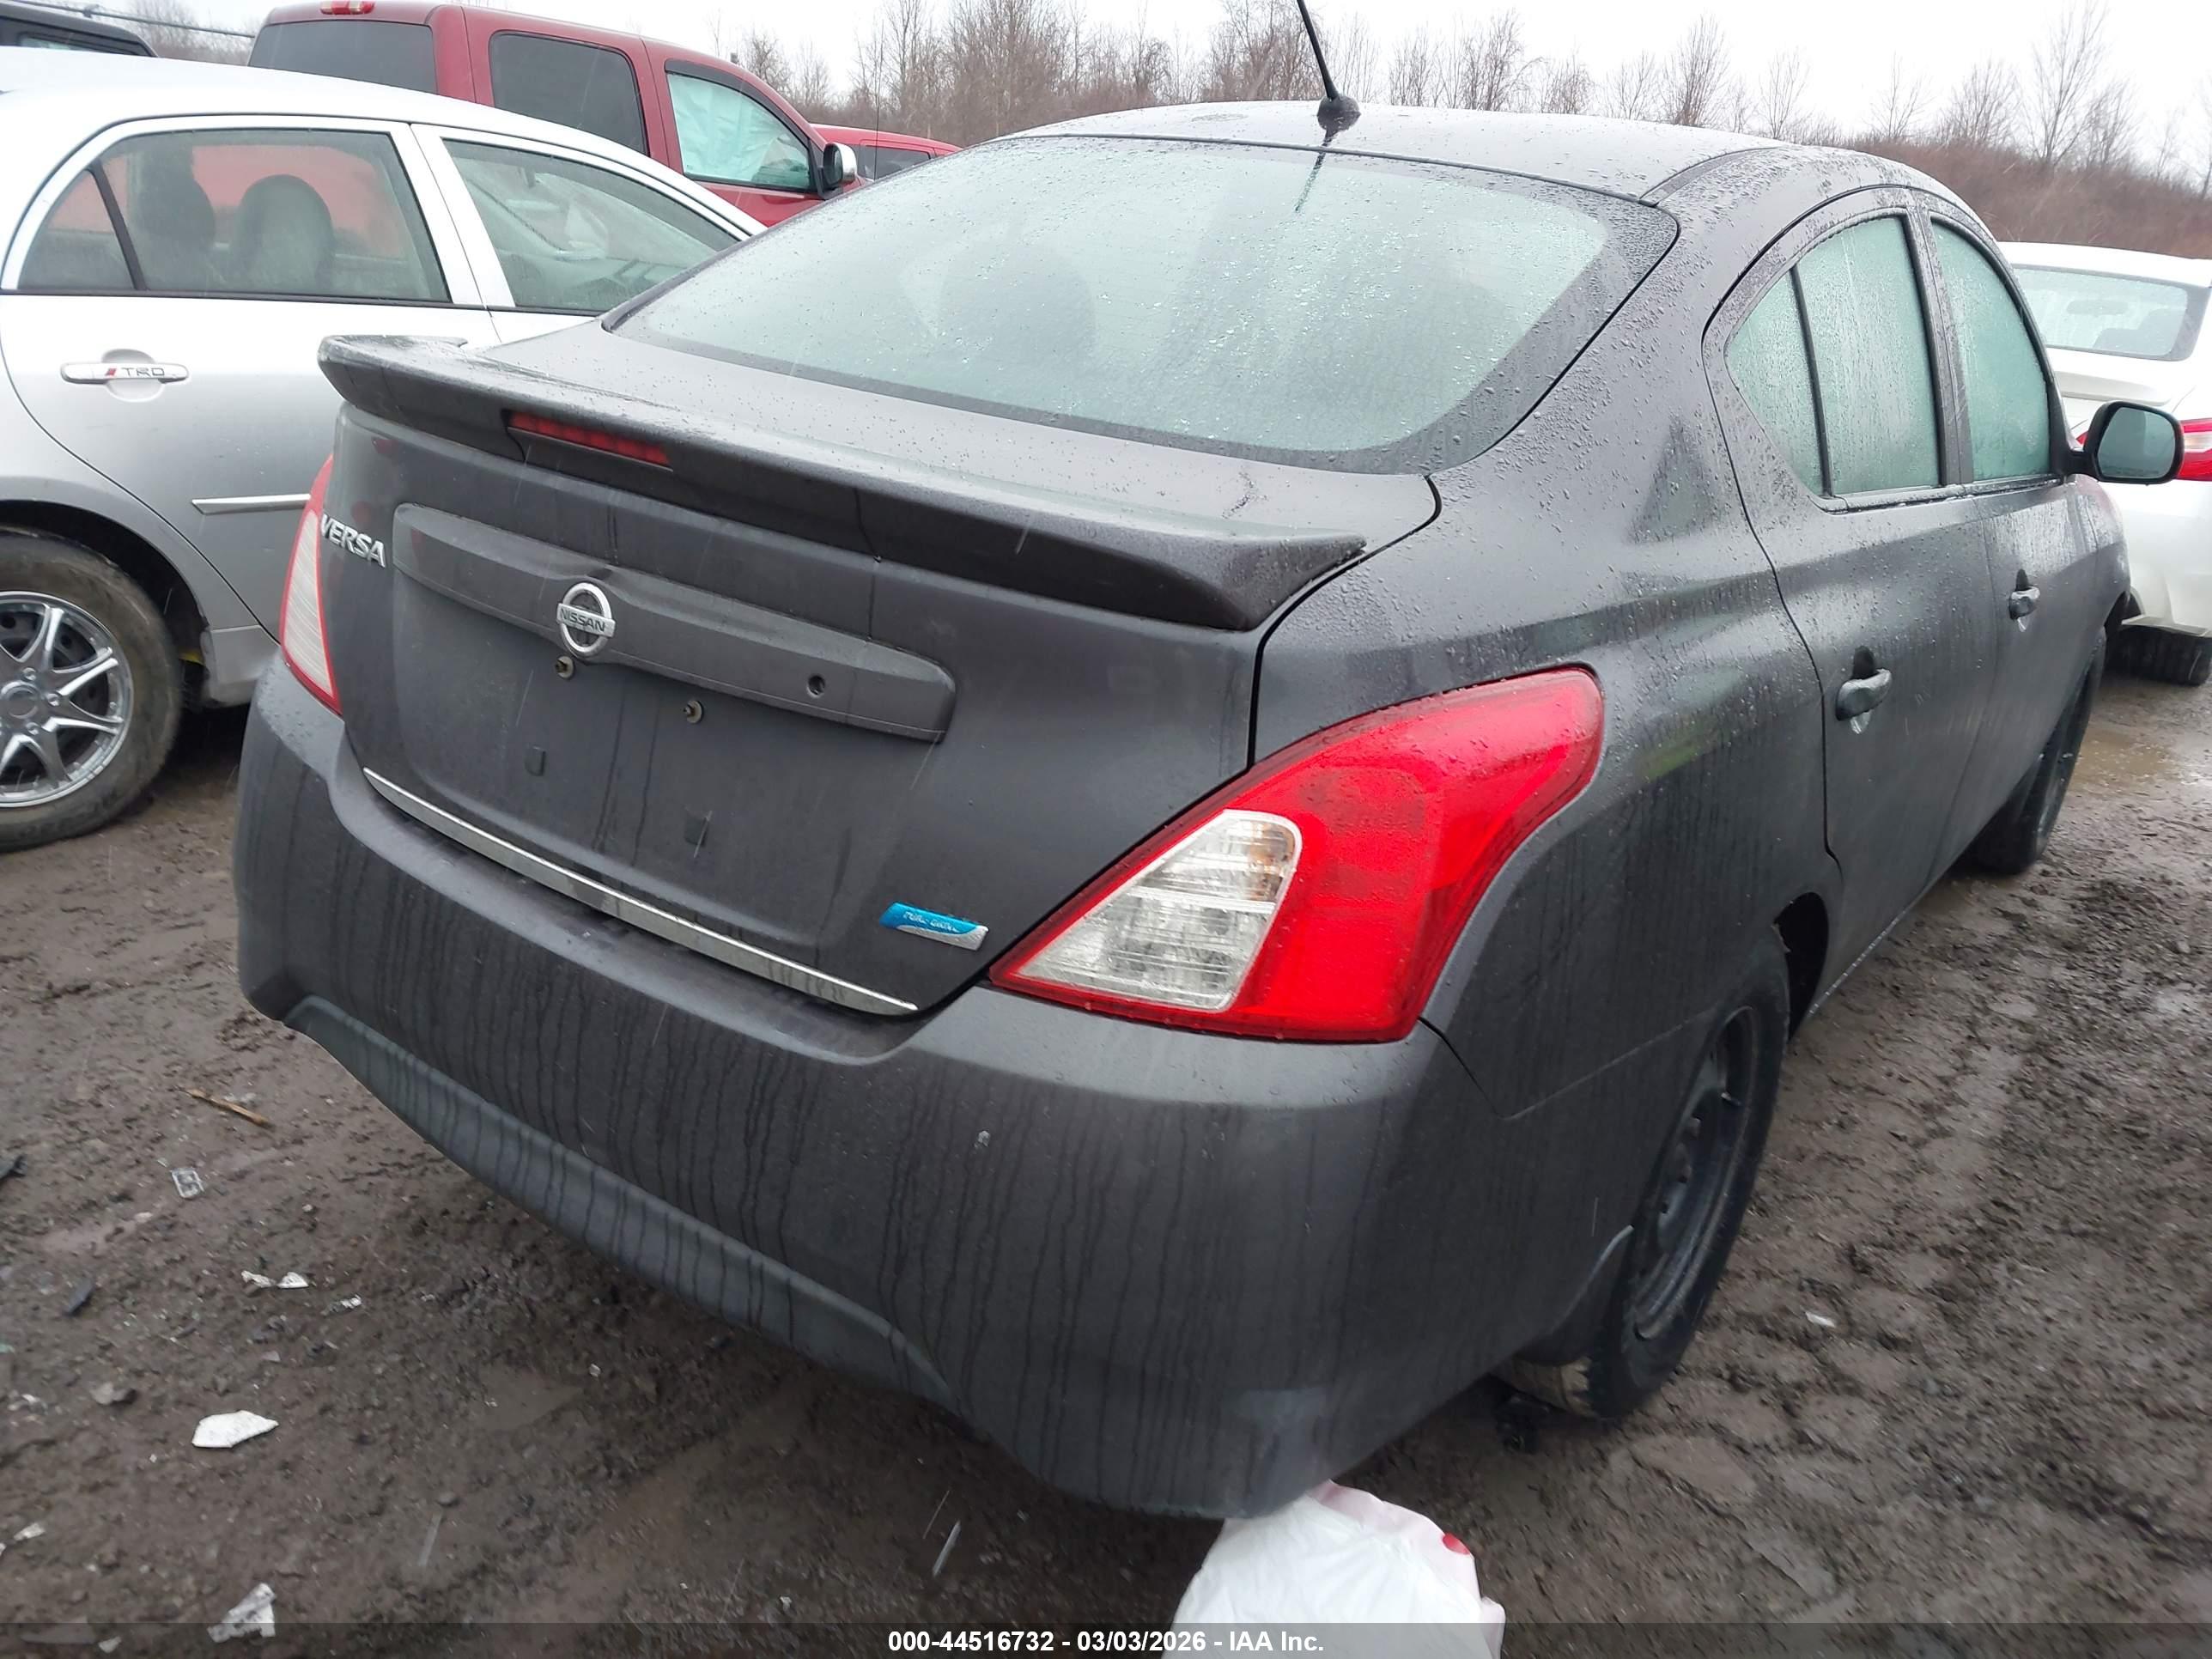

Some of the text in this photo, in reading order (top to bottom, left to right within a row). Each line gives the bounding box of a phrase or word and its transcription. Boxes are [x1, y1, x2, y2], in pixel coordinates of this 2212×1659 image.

[121, 367, 165, 378] TRD
[321, 514, 386, 568] VERSA
[561, 607, 605, 632] NISSAN
